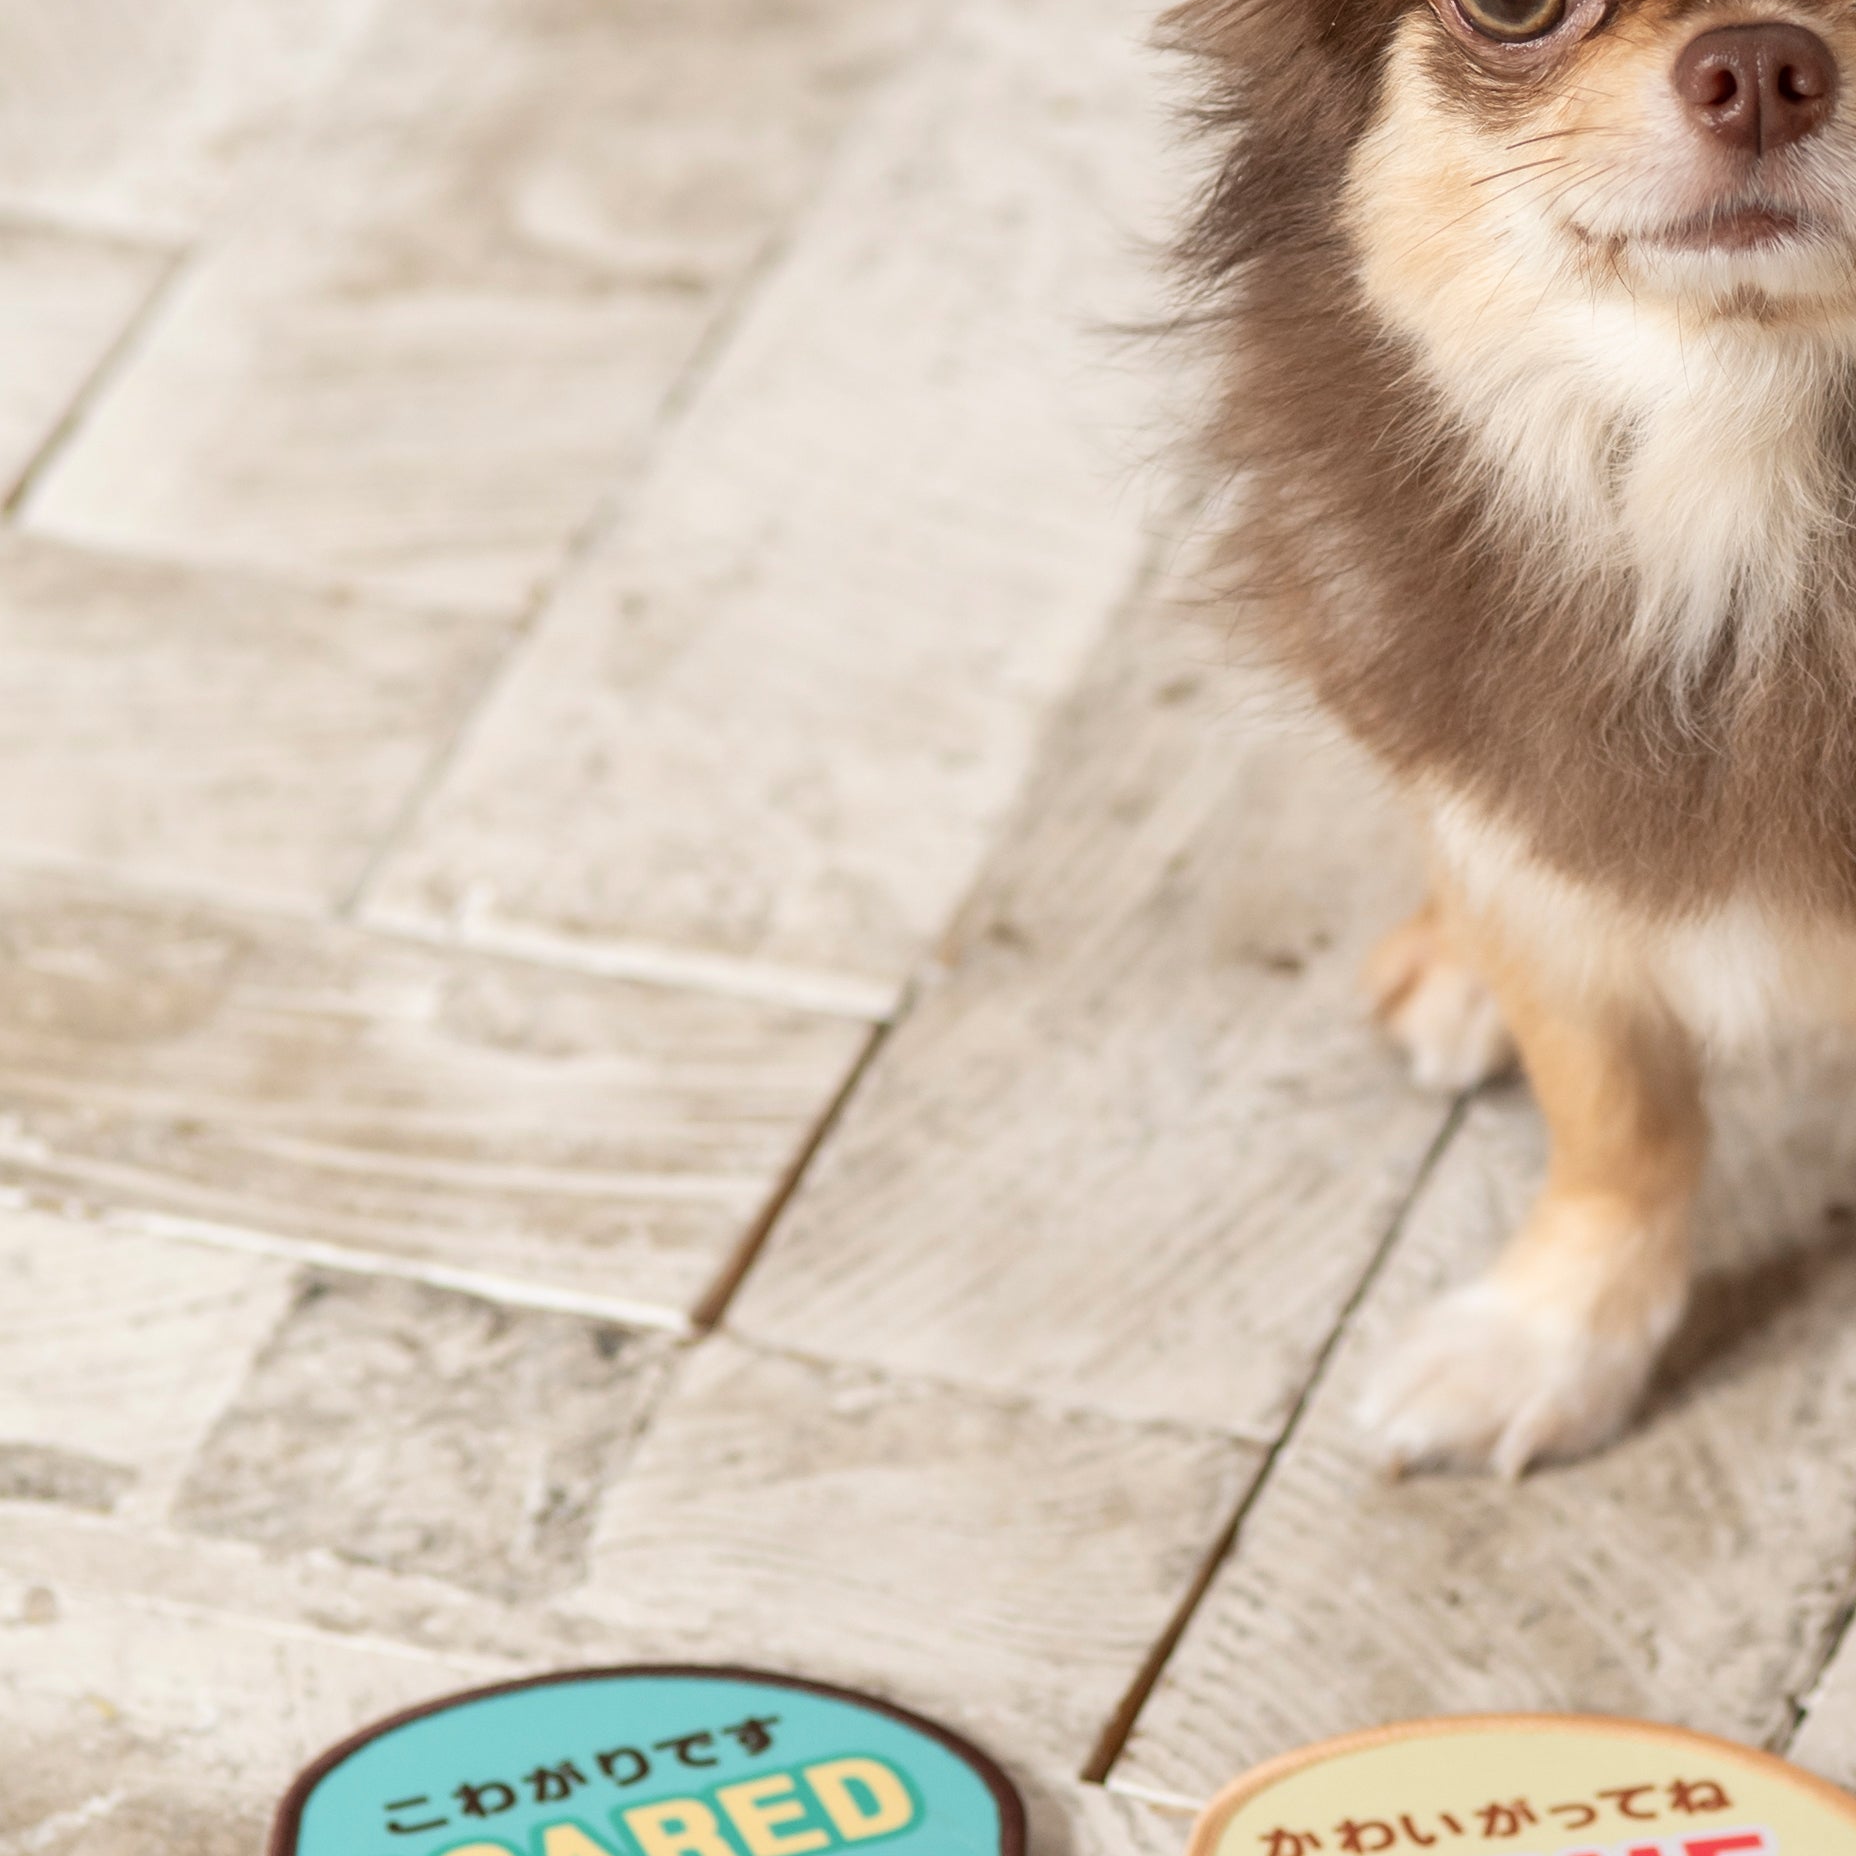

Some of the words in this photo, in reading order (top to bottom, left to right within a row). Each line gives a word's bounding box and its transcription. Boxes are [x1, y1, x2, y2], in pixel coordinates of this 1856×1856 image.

[385, 1716, 780, 1834] こわがりです
